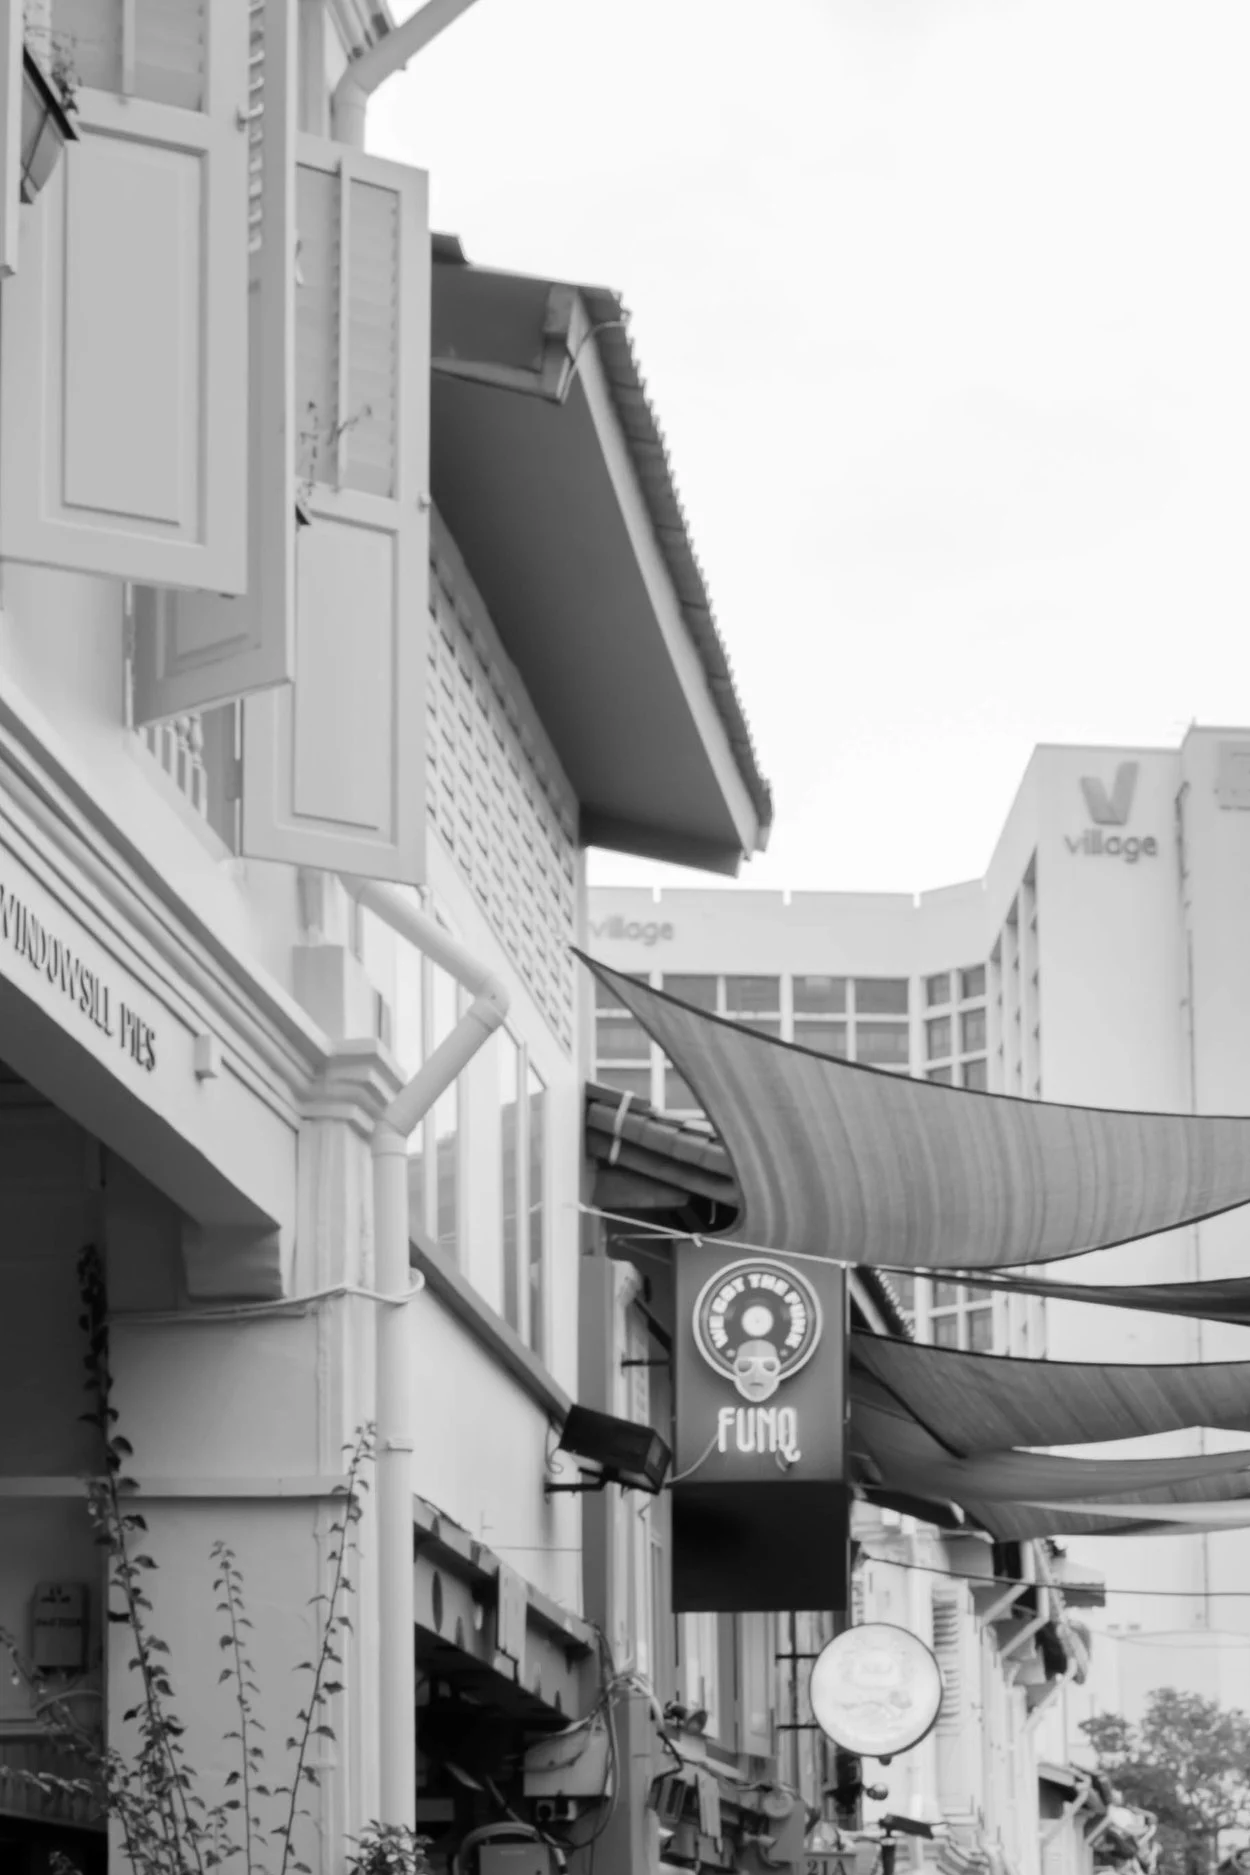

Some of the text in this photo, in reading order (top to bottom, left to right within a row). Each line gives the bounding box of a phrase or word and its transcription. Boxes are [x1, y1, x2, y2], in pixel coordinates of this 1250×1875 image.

[1062, 829, 1158, 864] village
[120, 1002, 156, 1071] PIES
[718, 1407, 801, 1463] FUNQ
